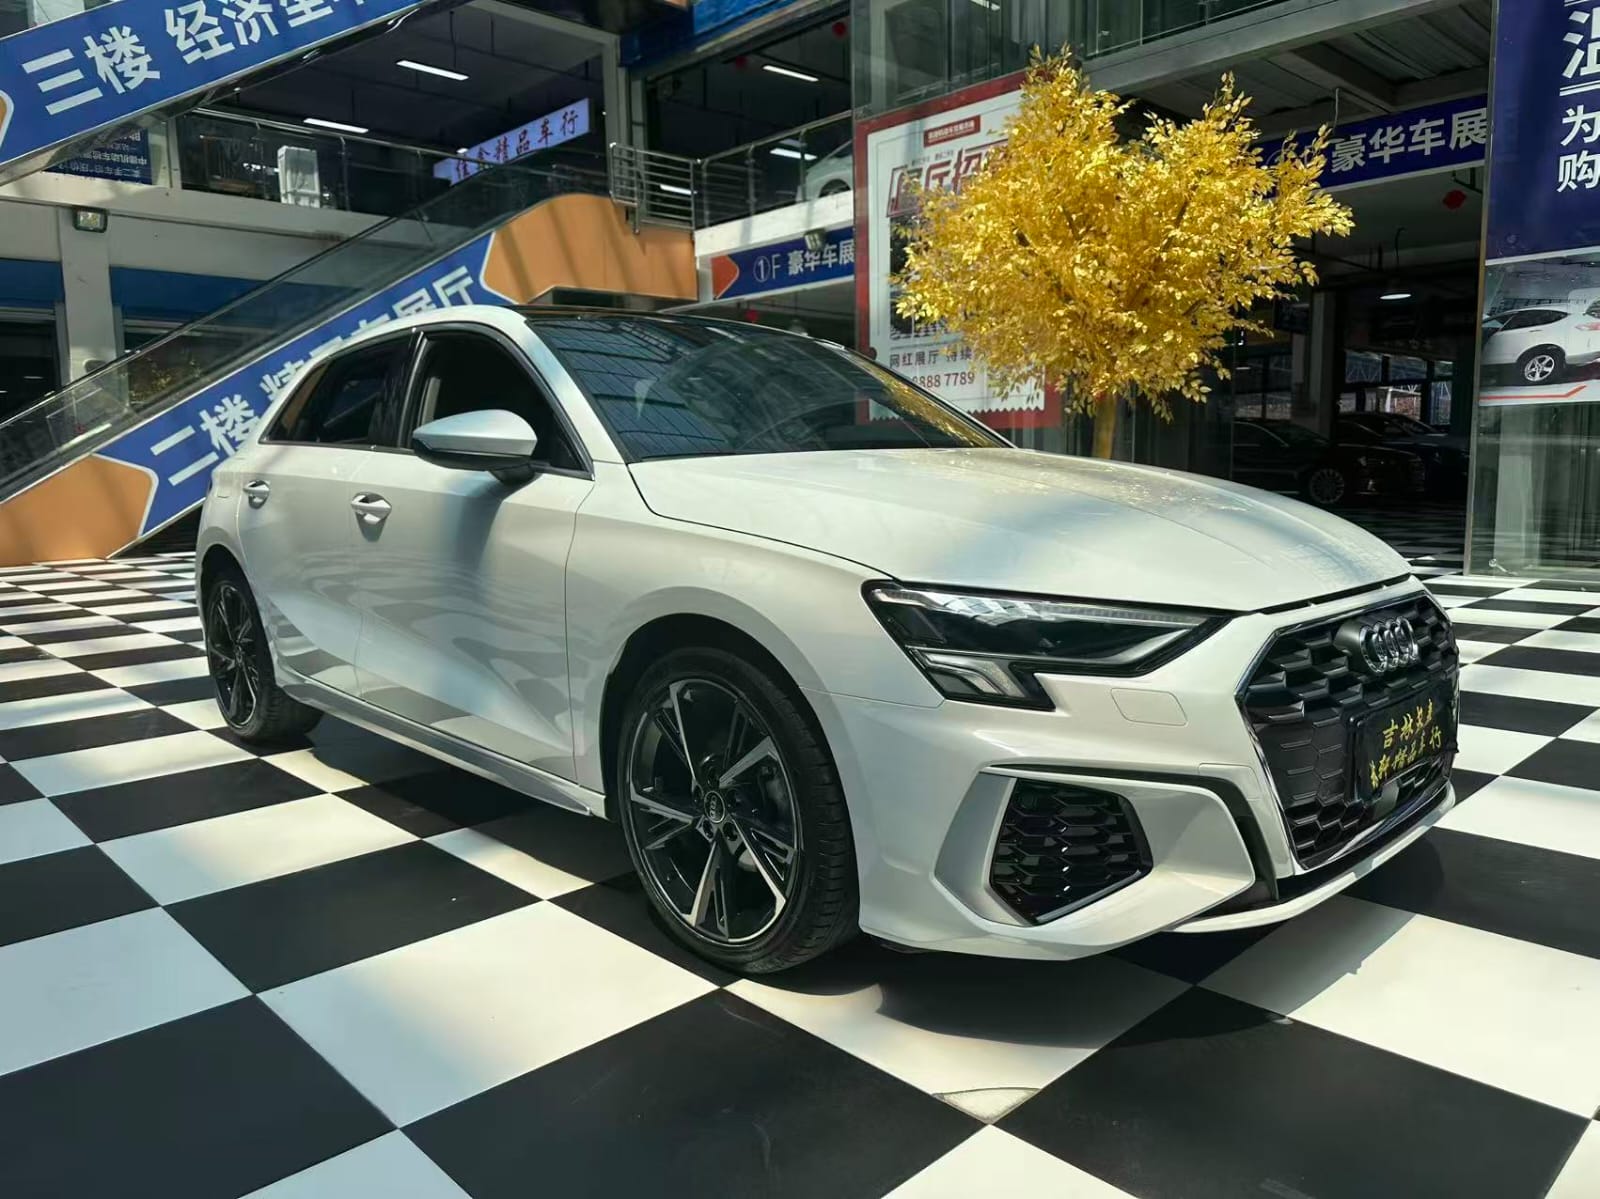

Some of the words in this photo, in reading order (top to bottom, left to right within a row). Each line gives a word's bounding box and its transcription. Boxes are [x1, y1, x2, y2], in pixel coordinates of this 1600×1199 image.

[22, 26, 160, 115] 三楼
[164, 0, 367, 64] 经济
[1330, 107, 1487, 174] 豪华车展
[788, 240, 855, 275] 豪华车展
[889, 349, 939, 368] 网红展厅
[944, 371, 975, 387] 7789
[150, 394, 263, 487] 二楼
